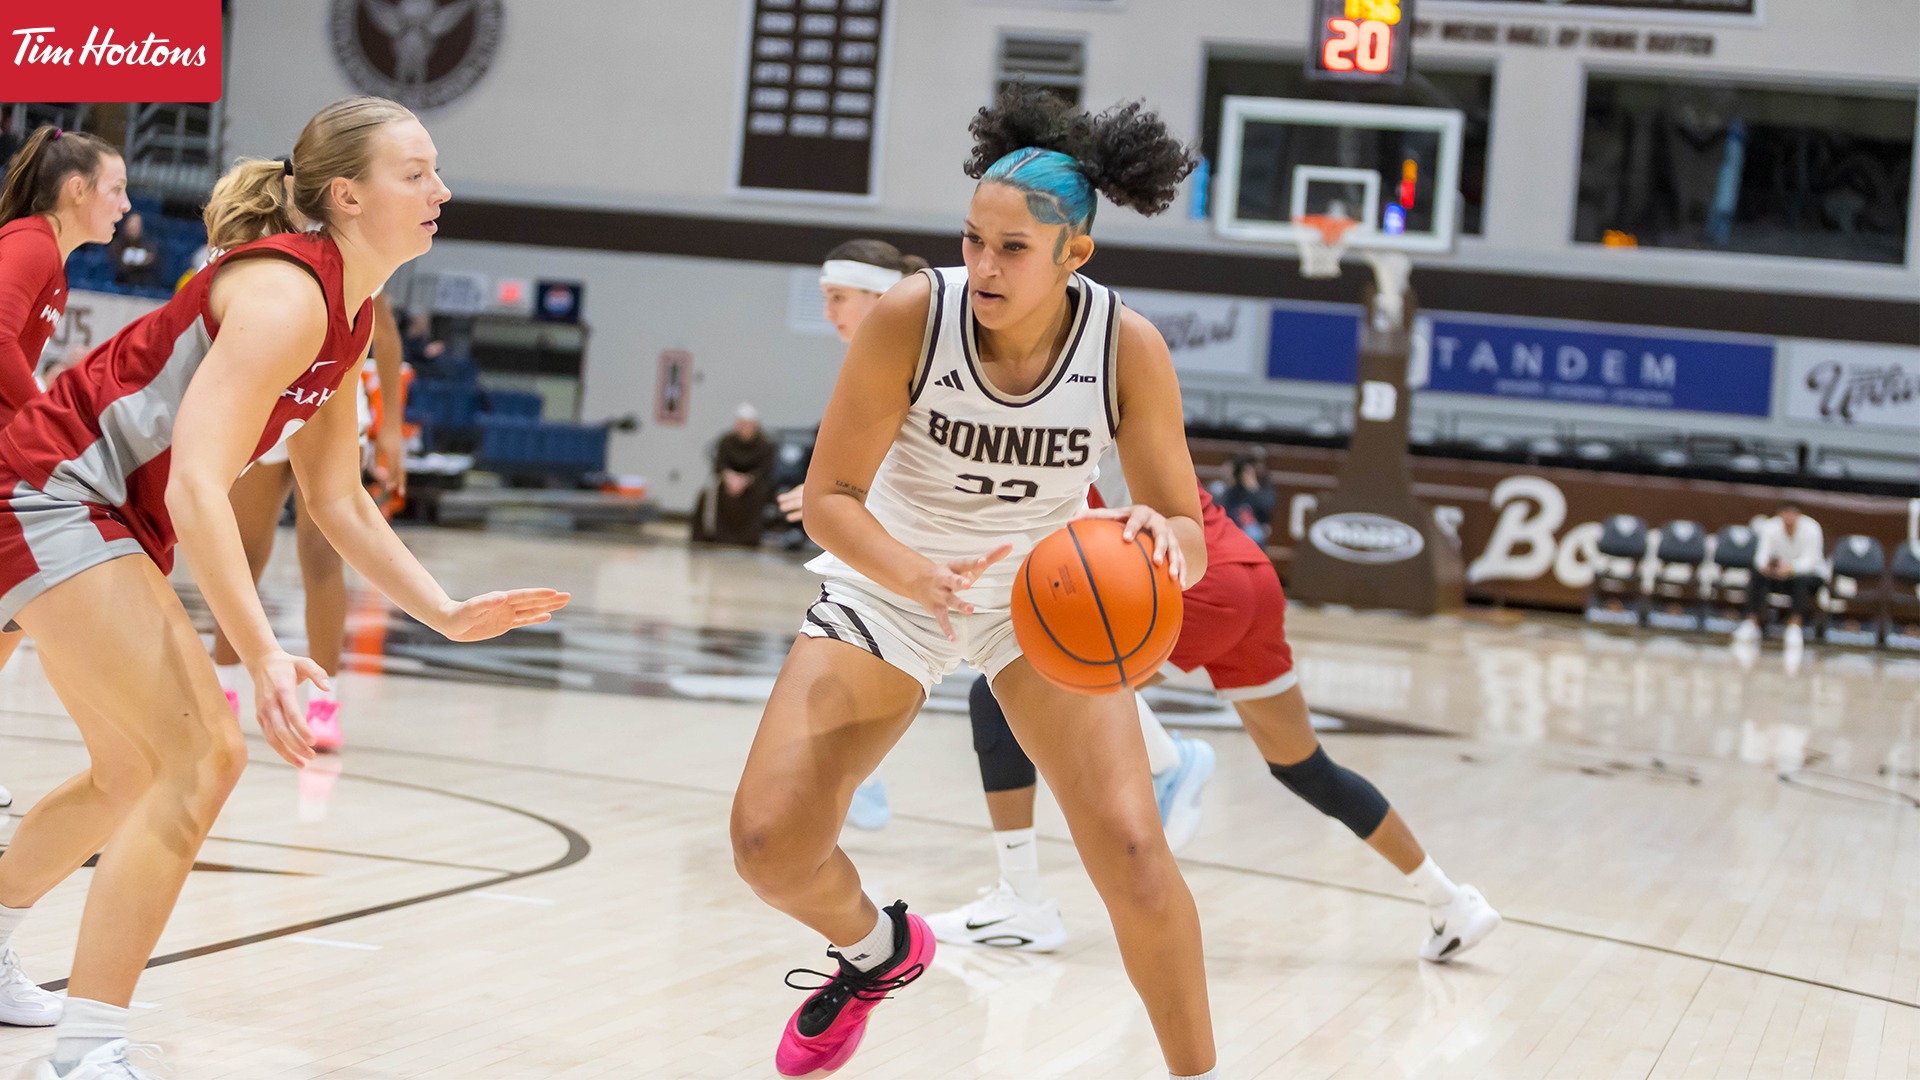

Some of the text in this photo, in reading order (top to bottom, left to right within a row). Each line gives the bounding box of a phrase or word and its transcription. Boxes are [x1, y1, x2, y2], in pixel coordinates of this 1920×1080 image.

[1322, 17, 1393, 74] 20
[1435, 335, 1678, 390] TANDEM
[929, 409, 1092, 469] BONNIES
